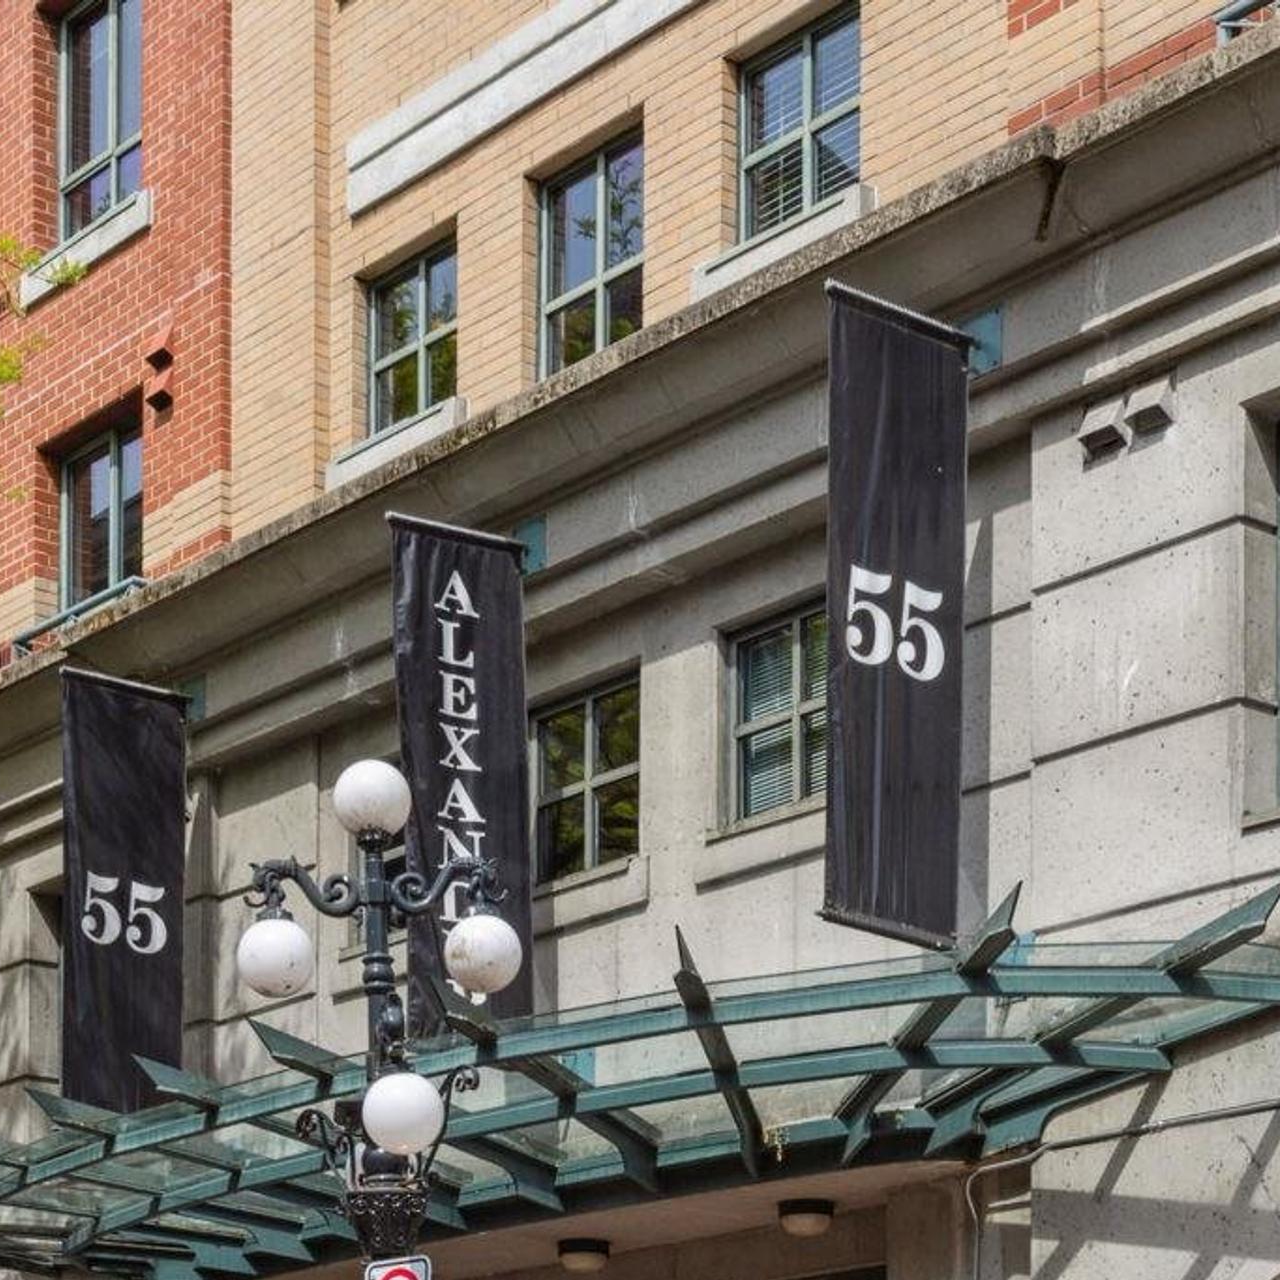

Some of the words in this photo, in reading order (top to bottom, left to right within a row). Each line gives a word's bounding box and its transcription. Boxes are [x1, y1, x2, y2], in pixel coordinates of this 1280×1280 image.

[845, 563, 946, 683] 55
[433, 569, 488, 1006] ALEXAN
[81, 869, 168, 954] 55
